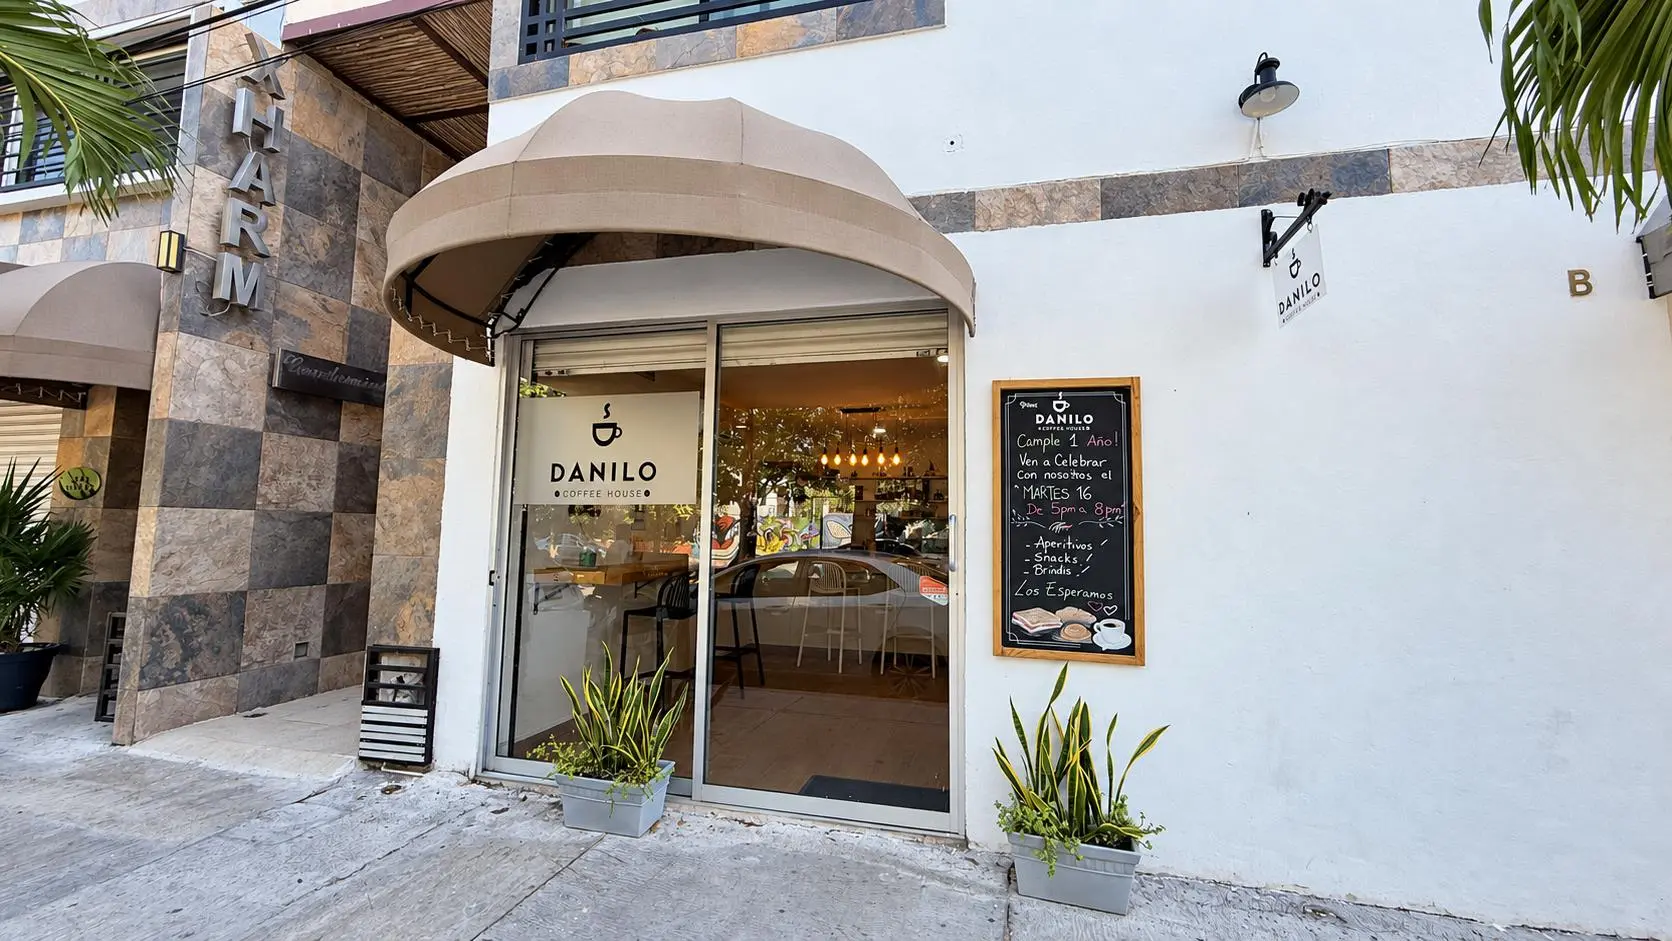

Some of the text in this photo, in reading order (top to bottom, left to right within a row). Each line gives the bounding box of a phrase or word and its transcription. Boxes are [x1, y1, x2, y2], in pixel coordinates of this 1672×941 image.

[1567, 269, 1593, 297] B
[1279, 273, 1320, 315] DANILO
[1035, 414, 1094, 424] DANILO
[1069, 433, 1078, 447] 1
[1019, 452, 1038, 467] Ven
[1054, 453, 1107, 467] Celebrar
[550, 461, 656, 482] DANILO
[1101, 470, 1112, 480] el
[563, 490, 642, 498] COFFEE HOUSE
[1023, 485, 1092, 500] MARTES 16
[1026, 503, 1044, 516] De
[1051, 502, 1076, 520] 5pm
[1034, 535, 1093, 554] Aperitivos
[1033, 564, 1072, 575] Brindis
[1014, 579, 1113, 600] Los Esperamos
